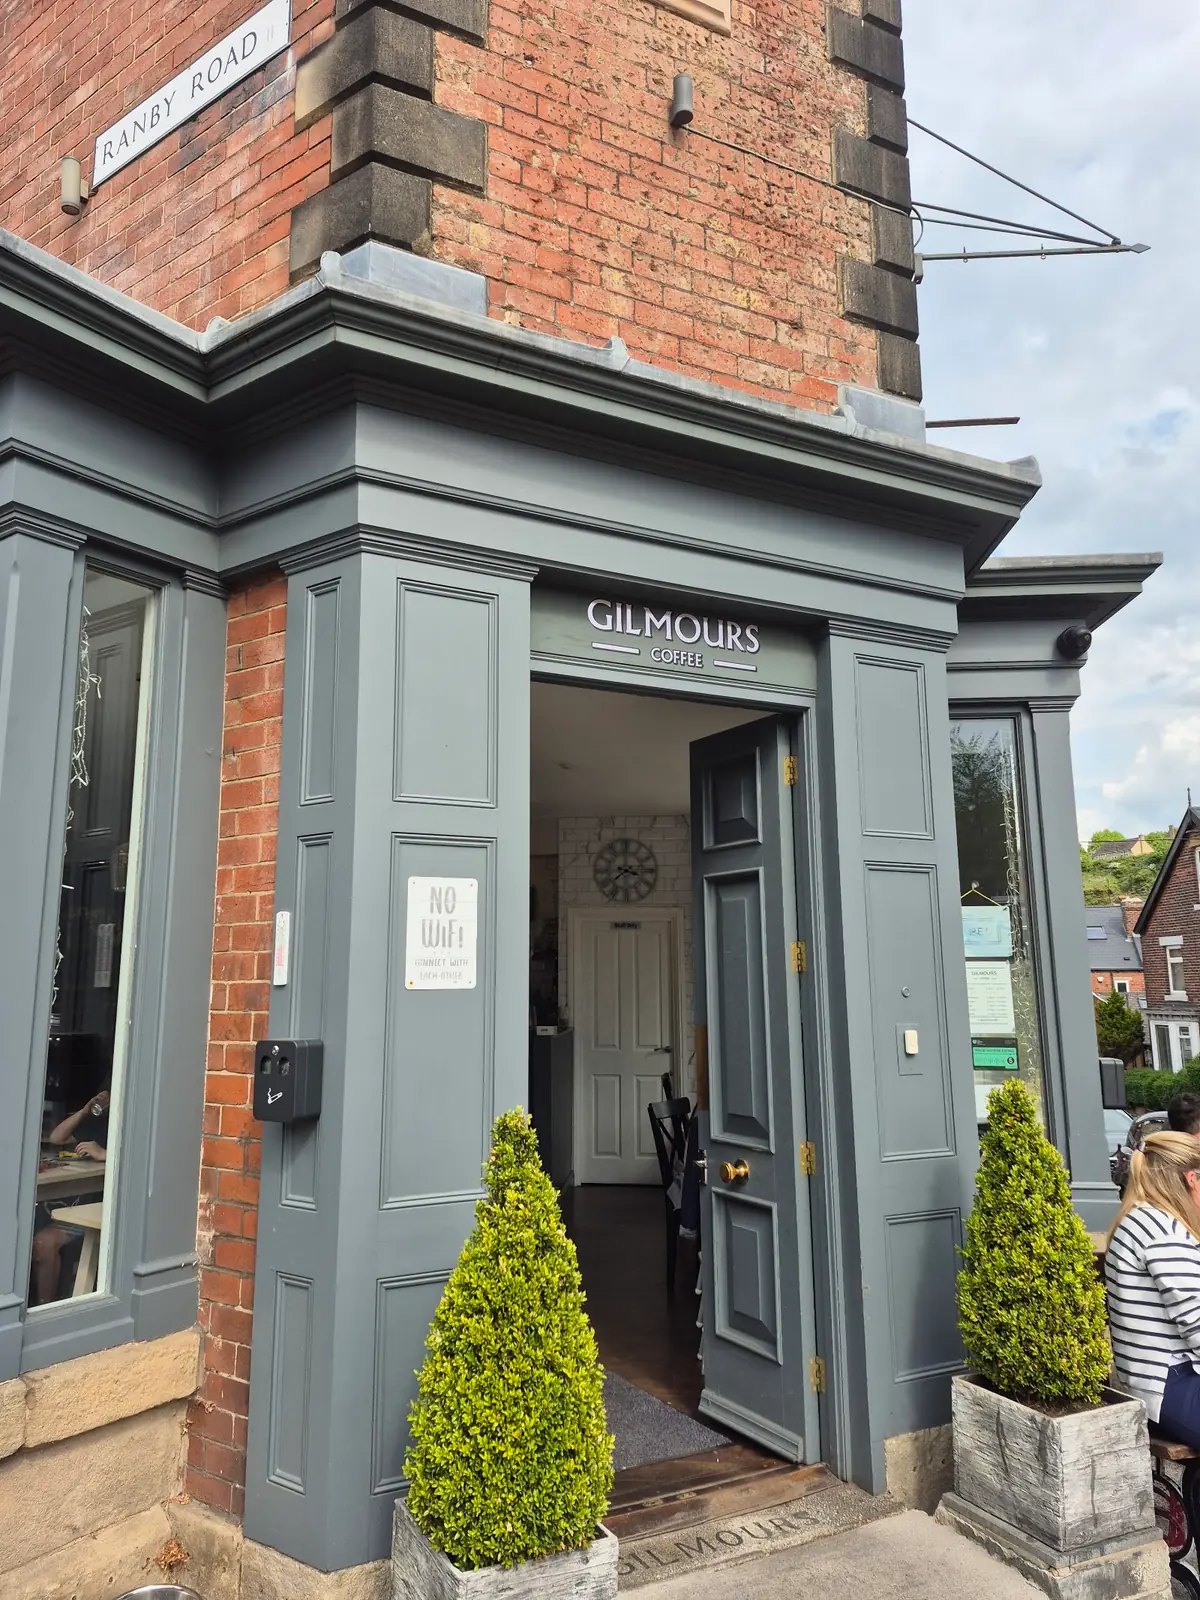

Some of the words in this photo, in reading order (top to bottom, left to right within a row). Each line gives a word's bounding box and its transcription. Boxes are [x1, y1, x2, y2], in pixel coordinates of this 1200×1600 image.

[102, 91, 176, 165] RANBY
[190, 31, 257, 99] ROAD
[587, 599, 760, 653] GILMOURS
[651, 647, 704, 668] COFFEE
[429, 886, 456, 914] NO
[449, 958, 469, 967] WITH
